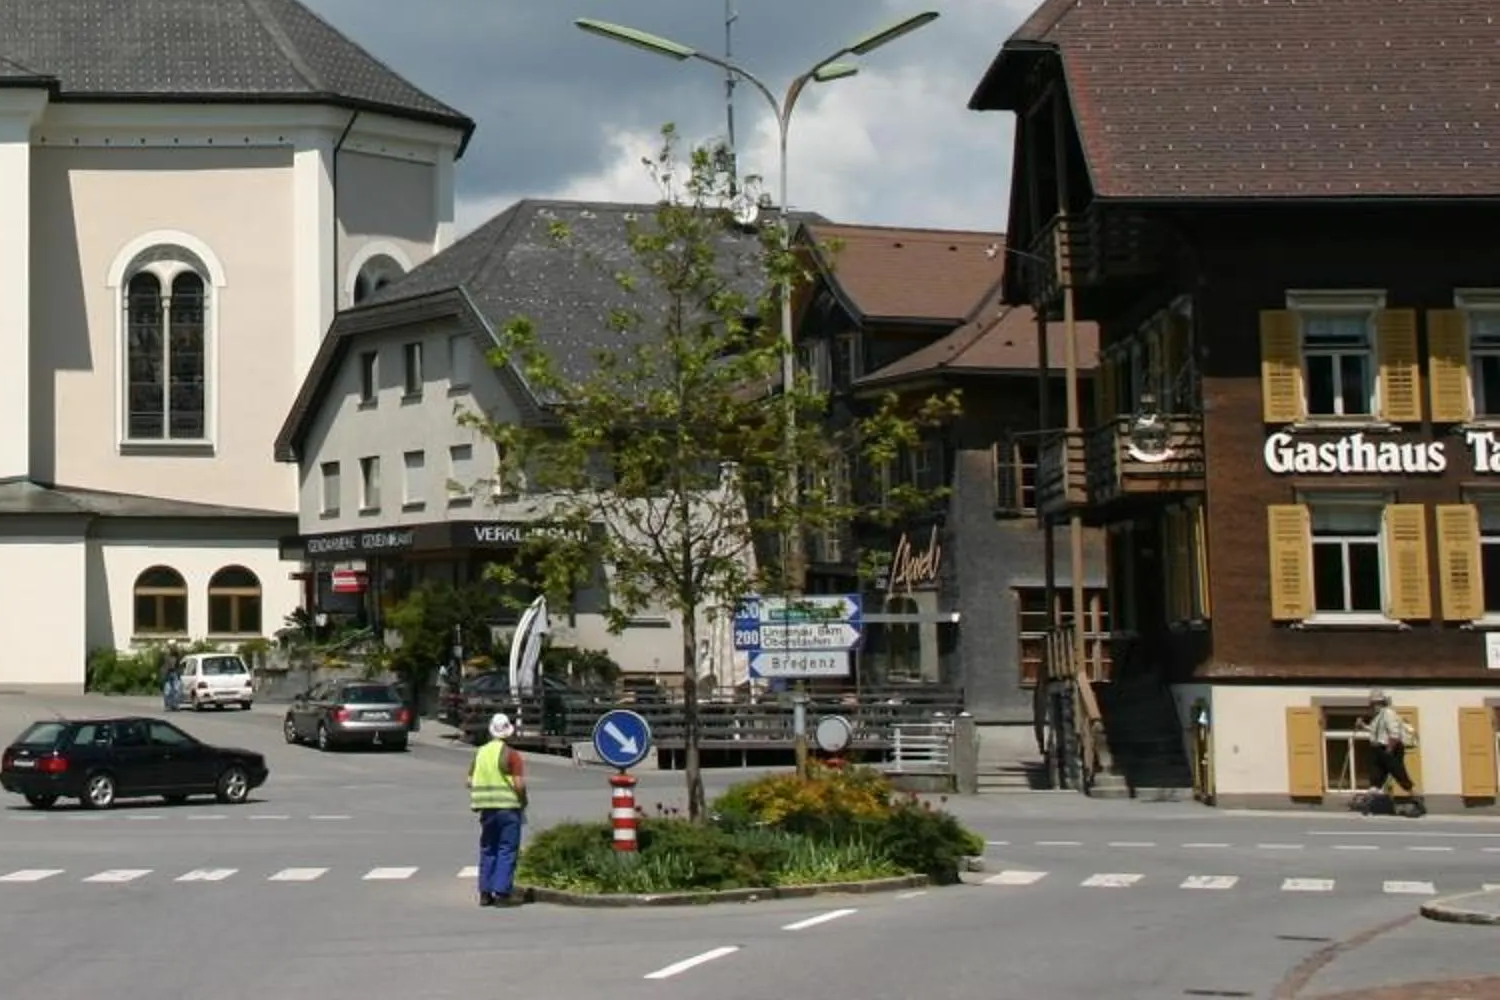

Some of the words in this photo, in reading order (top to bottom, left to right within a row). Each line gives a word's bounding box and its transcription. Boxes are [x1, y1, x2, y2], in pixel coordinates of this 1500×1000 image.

[1264, 432, 1447, 473] Gasthaus
[736, 630, 759, 645] 200
[763, 627, 813, 639] Lingenau
[771, 657, 837, 670] Bregenz
